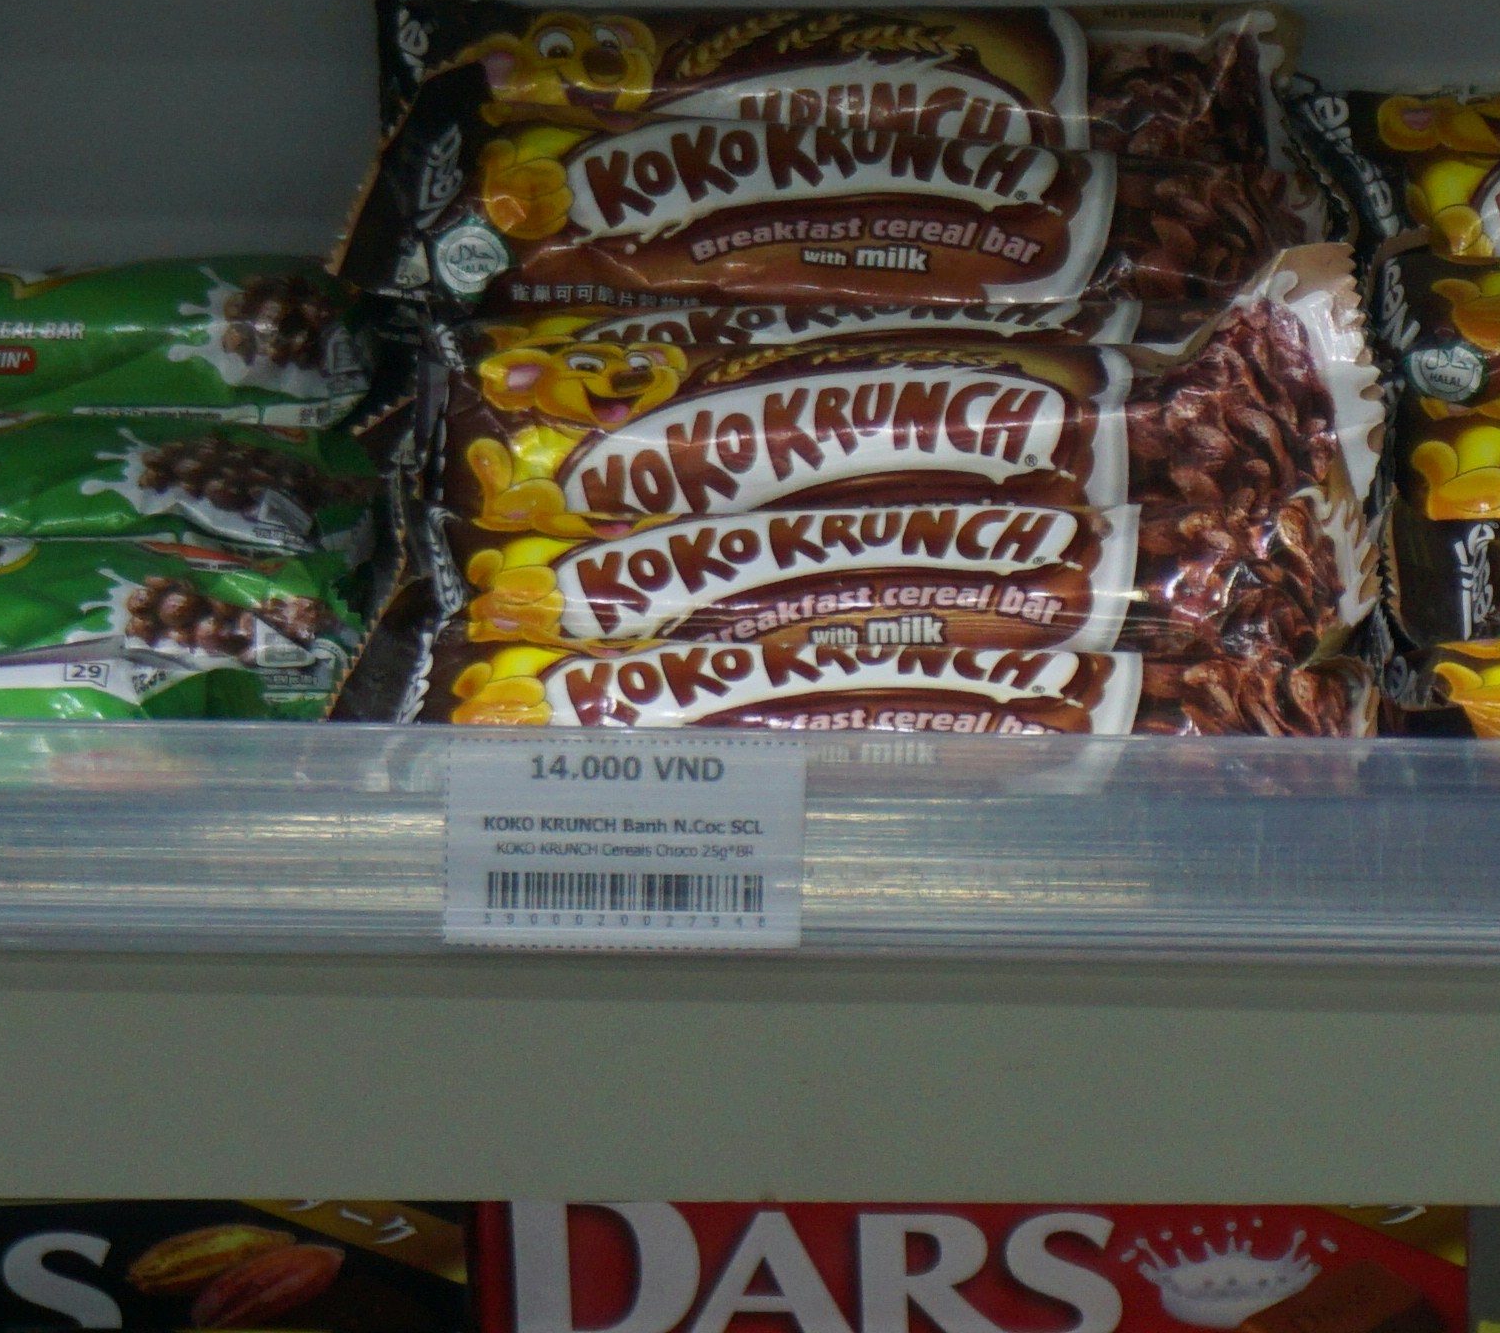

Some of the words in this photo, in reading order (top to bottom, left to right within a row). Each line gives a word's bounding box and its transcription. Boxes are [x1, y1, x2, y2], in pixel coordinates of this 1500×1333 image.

[693, 219, 864, 263] Breakfast
[869, 215, 978, 246] cereal
[983, 222, 1041, 266] bar
[580, 408, 760, 519] KOKO
[760, 378, 1050, 483] KRUNCH
[574, 526, 764, 626] KOKO
[768, 505, 1050, 579] KRUNCH
[531, 755, 643, 781] 14.000
[654, 756, 725, 782] VND
[484, 816, 534, 832] KOKO
[540, 817, 617, 833] KRUNCH
[623, 818, 668, 834] Banh
[731, 820, 764, 835] SCL
[508, 1197, 1132, 1333] DARS
